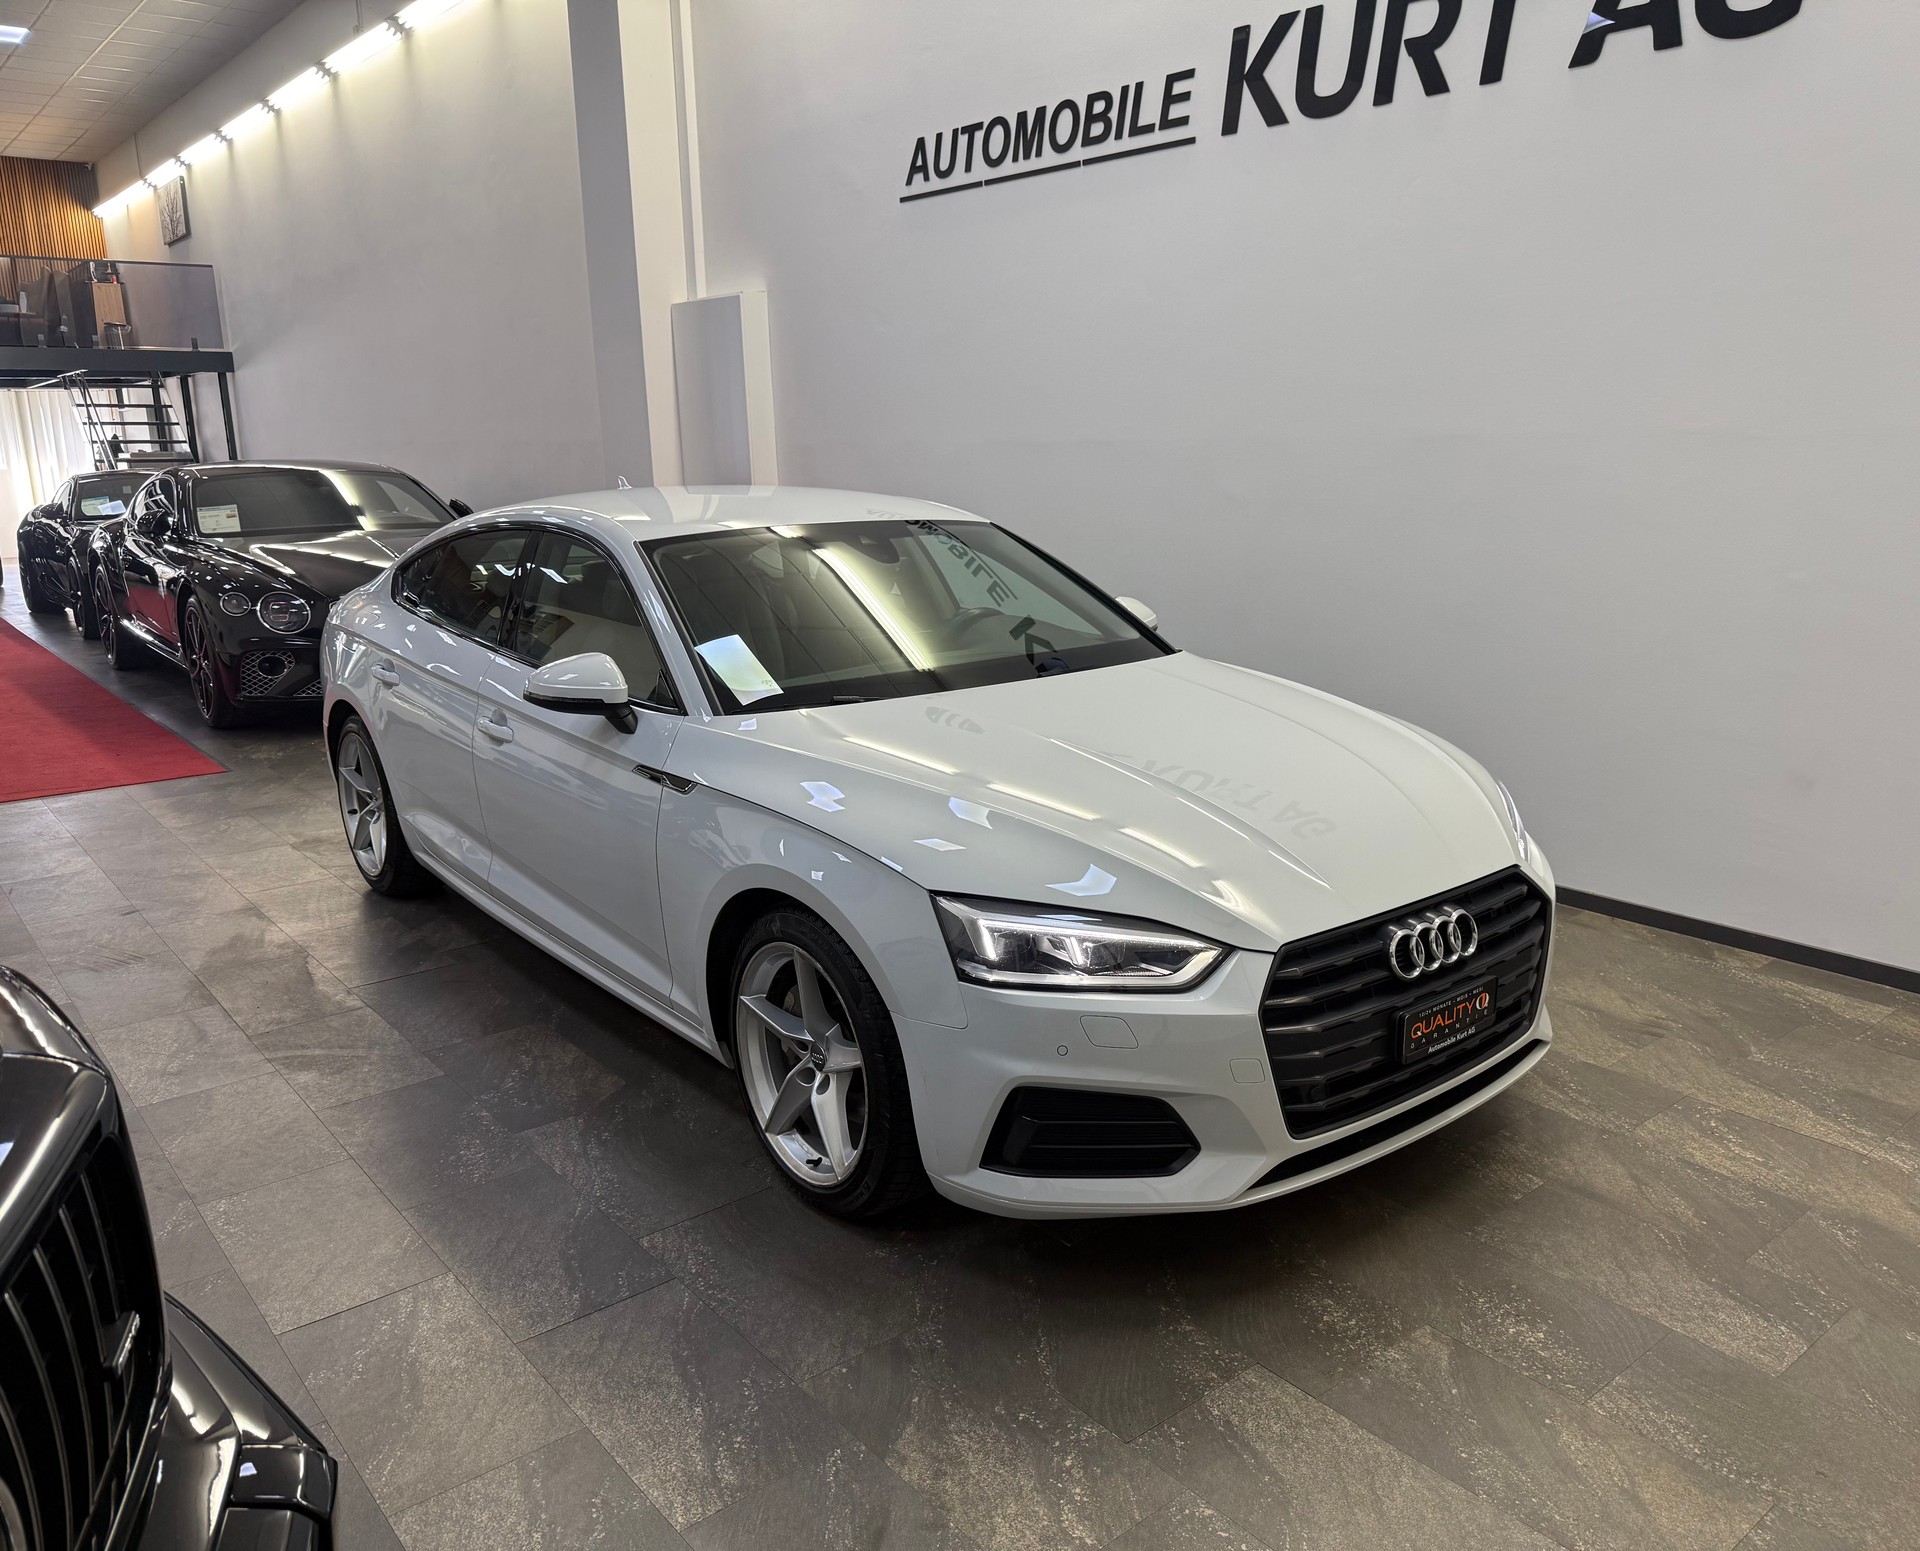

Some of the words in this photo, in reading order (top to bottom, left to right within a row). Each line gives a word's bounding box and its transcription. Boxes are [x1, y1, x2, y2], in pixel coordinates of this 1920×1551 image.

[905, 68, 1196, 186] AUTOMOBILE
[1428, 1036, 1456, 1053] Automobile
[1456, 1030, 1468, 1041] Kurt
